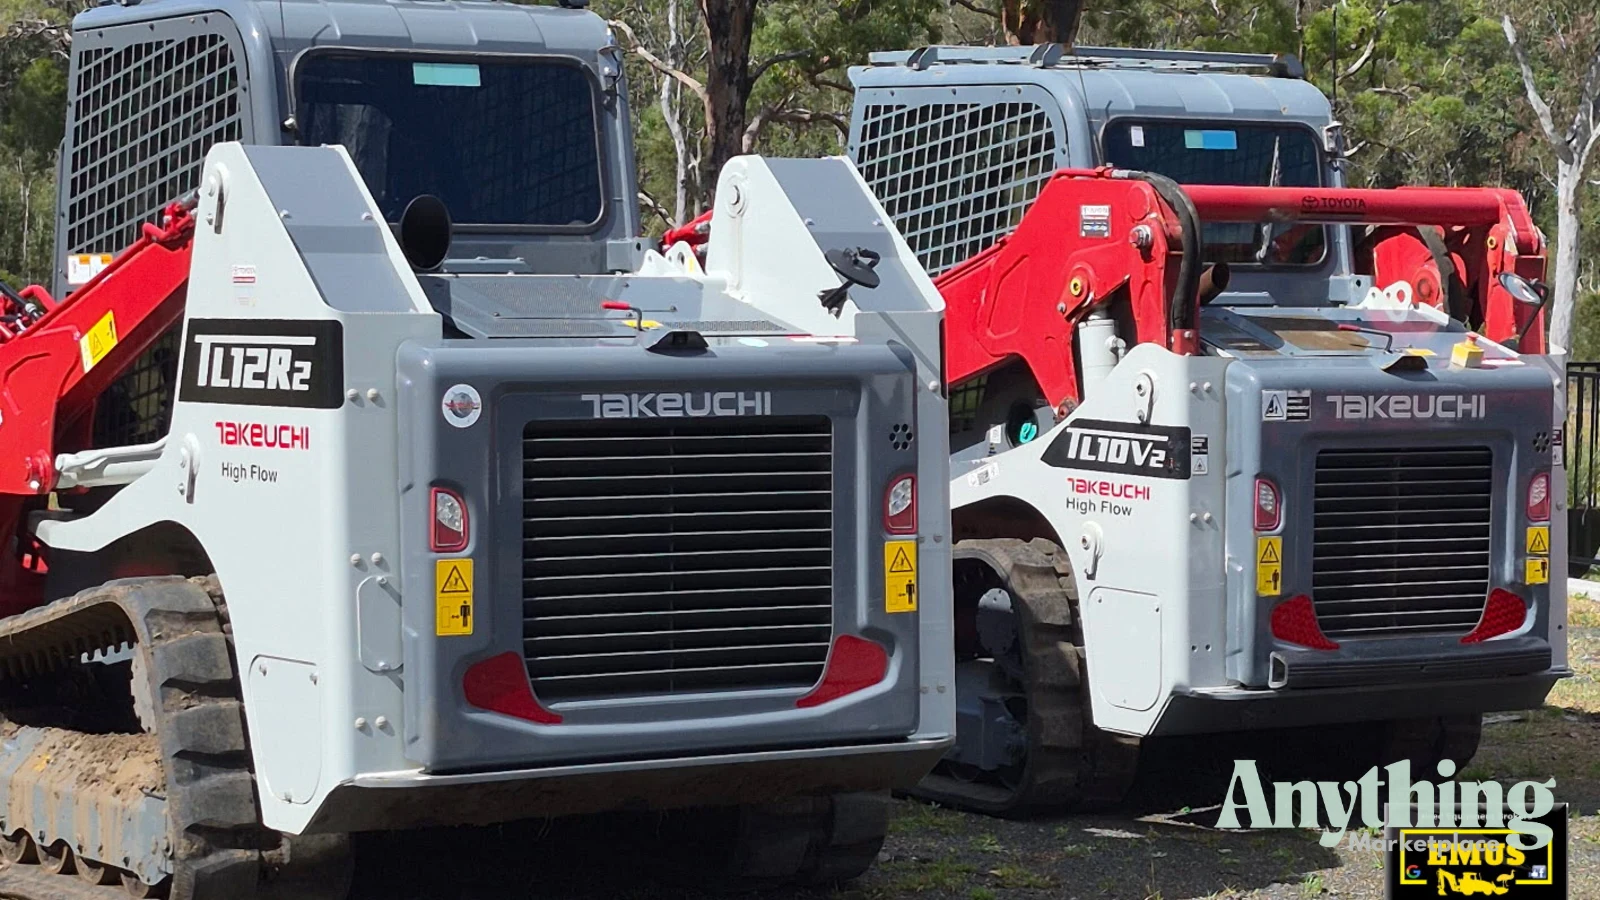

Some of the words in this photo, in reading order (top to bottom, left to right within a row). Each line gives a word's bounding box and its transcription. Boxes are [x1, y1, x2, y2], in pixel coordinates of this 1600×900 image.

[1321, 197, 1367, 209] TOYOTA
[194, 334, 317, 391] TL12R2
[1066, 426, 1169, 468] TL10V2
[221, 462, 247, 482] High
[250, 465, 278, 482] Flow
[1066, 498, 1096, 515] High
[1101, 501, 1132, 516] Flow
